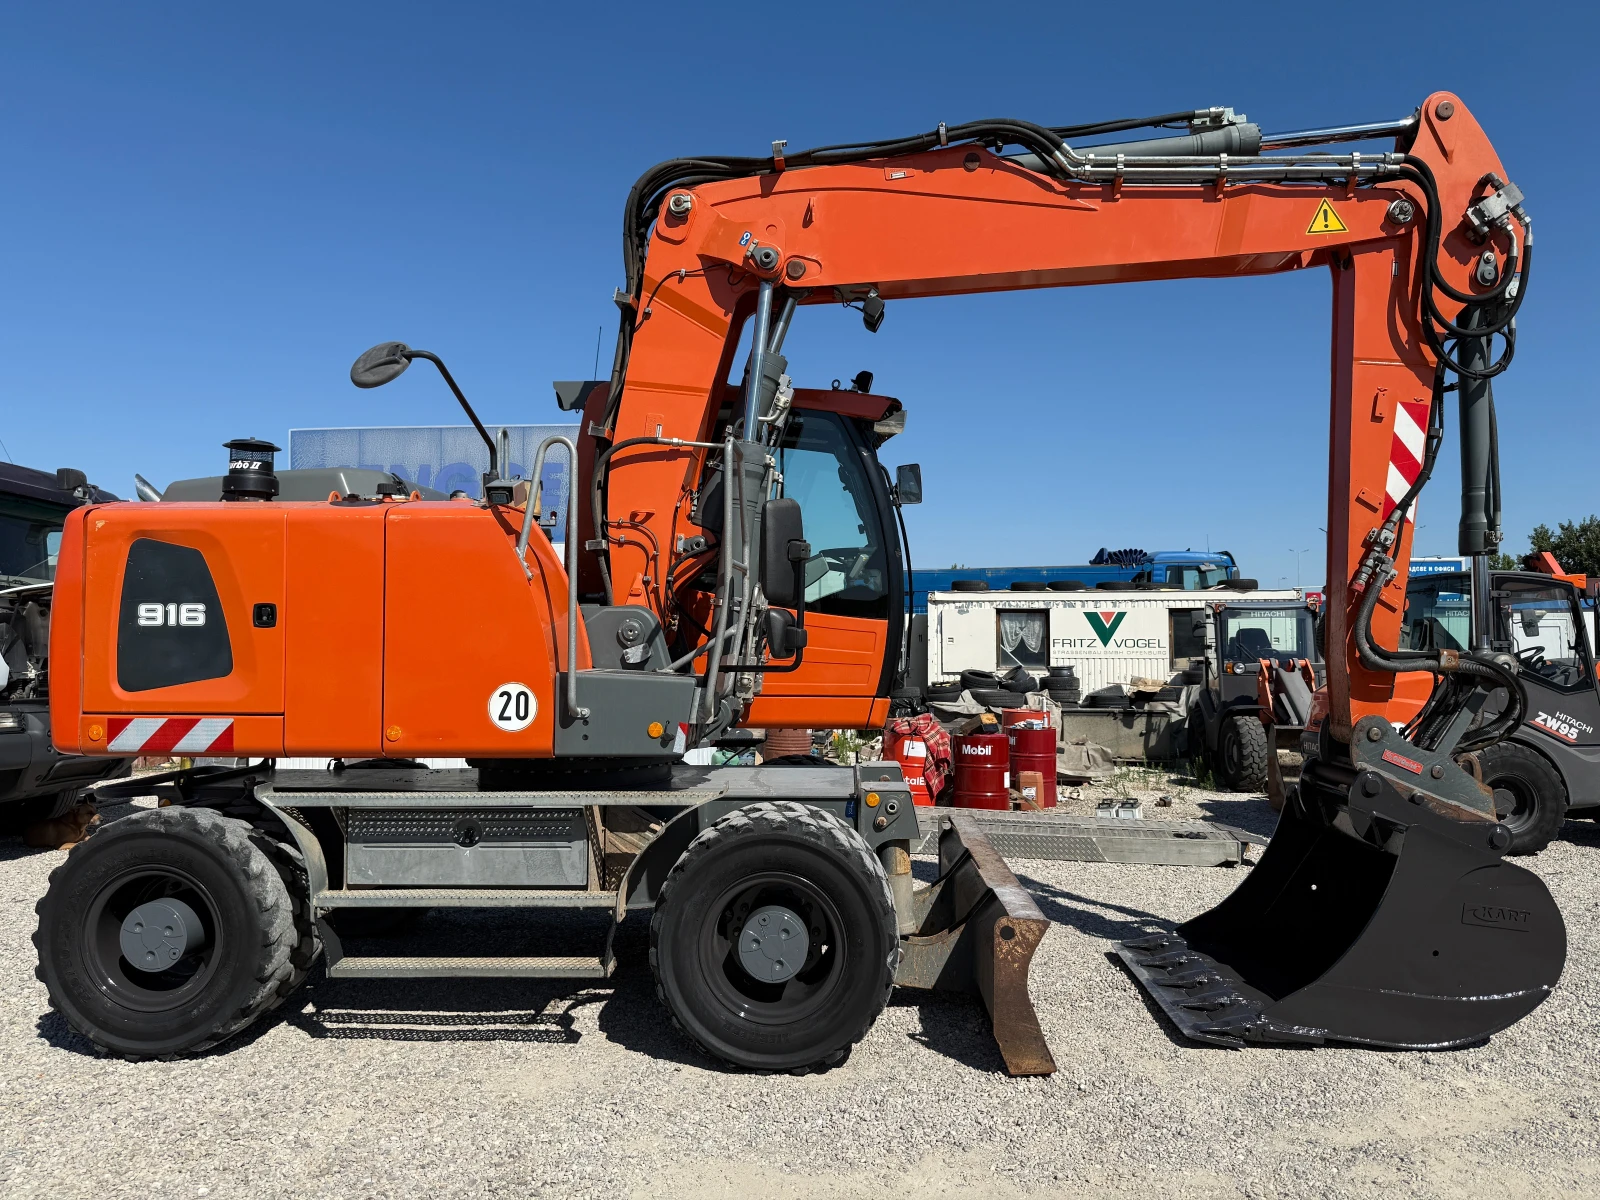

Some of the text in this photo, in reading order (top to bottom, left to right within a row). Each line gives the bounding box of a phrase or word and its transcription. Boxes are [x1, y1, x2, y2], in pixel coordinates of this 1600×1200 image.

[137, 602, 207, 627] 916
[1052, 639, 1167, 648] FRITZ VOGEL
[498, 690, 530, 721] 20
[1534, 711, 1579, 740] ZW95
[1555, 711, 1594, 734] HITACHI
[962, 744, 993, 756] Mobil
